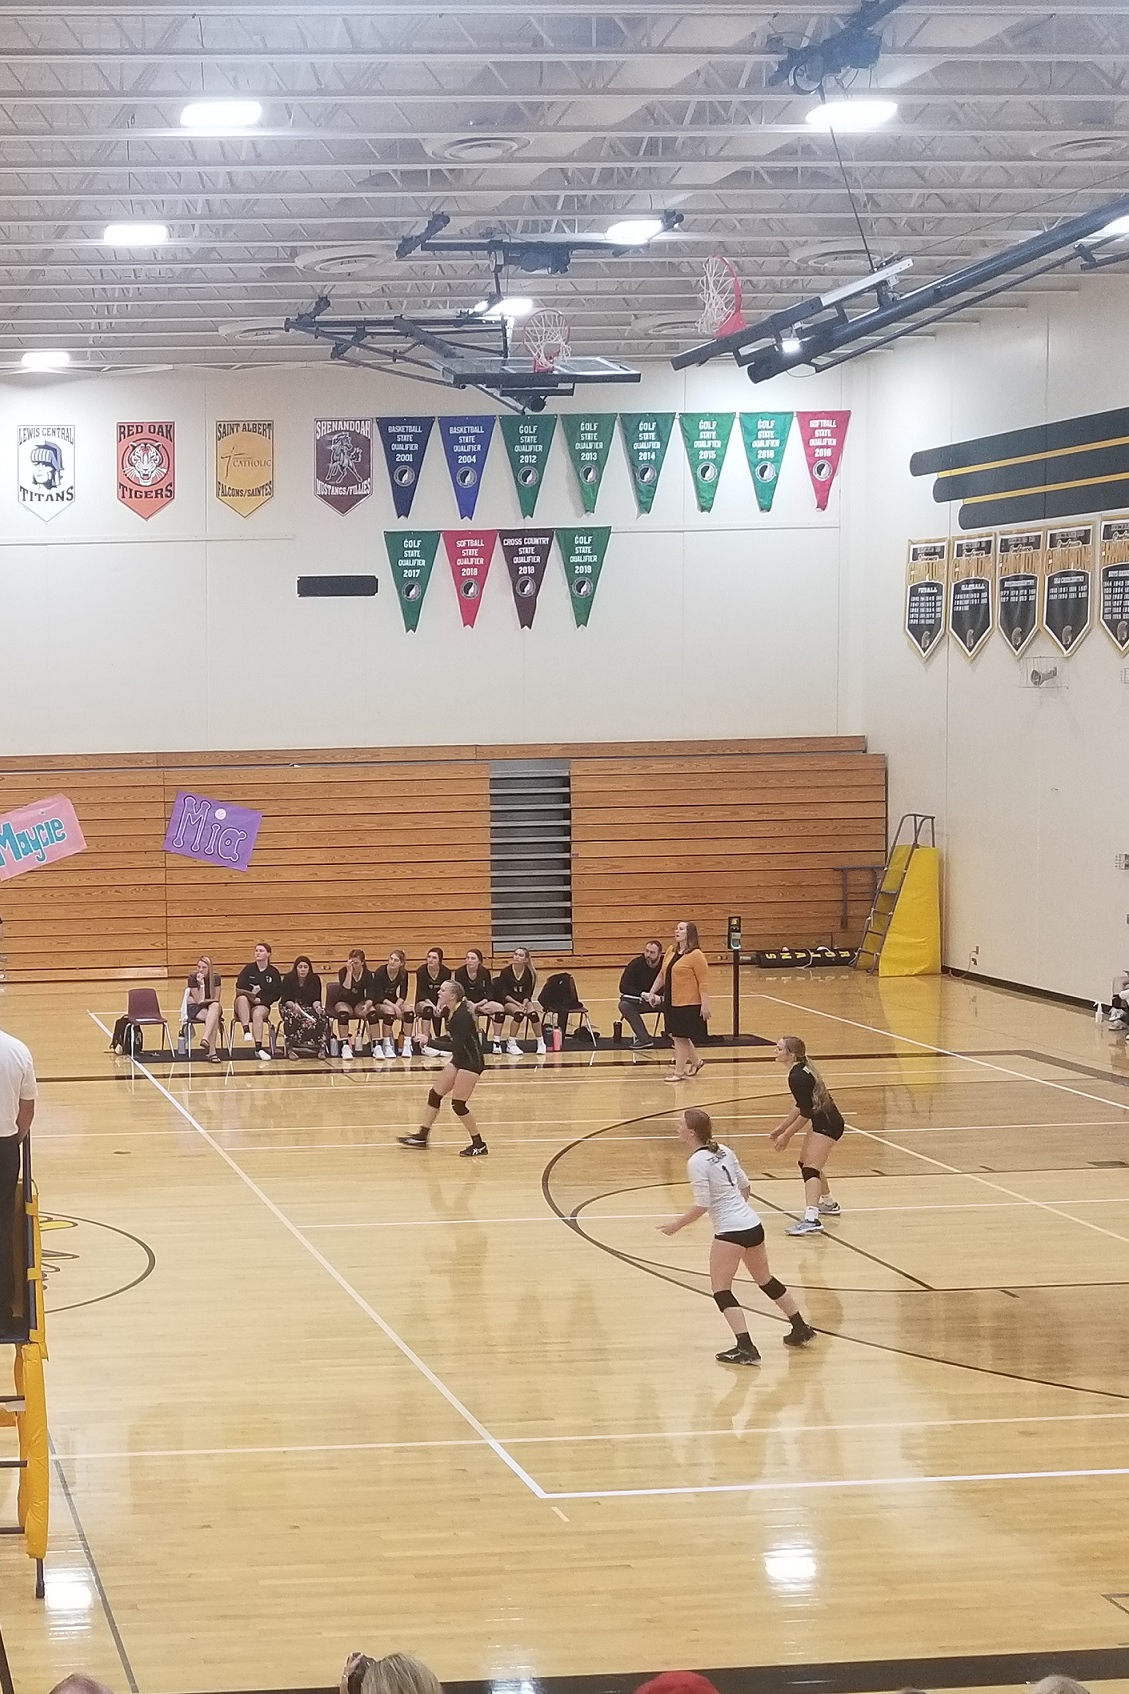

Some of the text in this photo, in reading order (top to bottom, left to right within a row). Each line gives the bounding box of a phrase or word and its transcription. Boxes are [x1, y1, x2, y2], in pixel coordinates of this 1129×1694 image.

[581, 423, 598, 431] GOLF
[639, 422, 656, 431] GOLF
[699, 421, 717, 430] GOLF
[758, 420, 775, 429] GOLF
[119, 424, 173, 442] RED OAK
[218, 423, 272, 440] SAINT ALBERT
[316, 421, 370, 440] SHENANDOAH
[450, 426, 484, 434] BASKETBALL
[519, 425, 538, 434] GOLF
[19, 428, 73, 445] LEWIS CENTRAL
[396, 454, 413, 462] 2001
[458, 455, 476, 463] 2004
[520, 455, 537, 463] 2012
[581, 453, 597, 461] 2013
[639, 452, 655, 460] 2014
[699, 451, 716, 459] 2015
[233, 460, 271, 468] CATHOLIC
[20, 486, 74, 502] TITANS
[119, 482, 173, 499] TIGERS
[404, 540, 421, 548] GOLF
[575, 536, 592, 544] GOLF
[575, 566, 591, 574] 2019
[172, 795, 247, 862] Mia
[765, 950, 851, 959] ROJANS
[721, 1165, 735, 1187] 1
